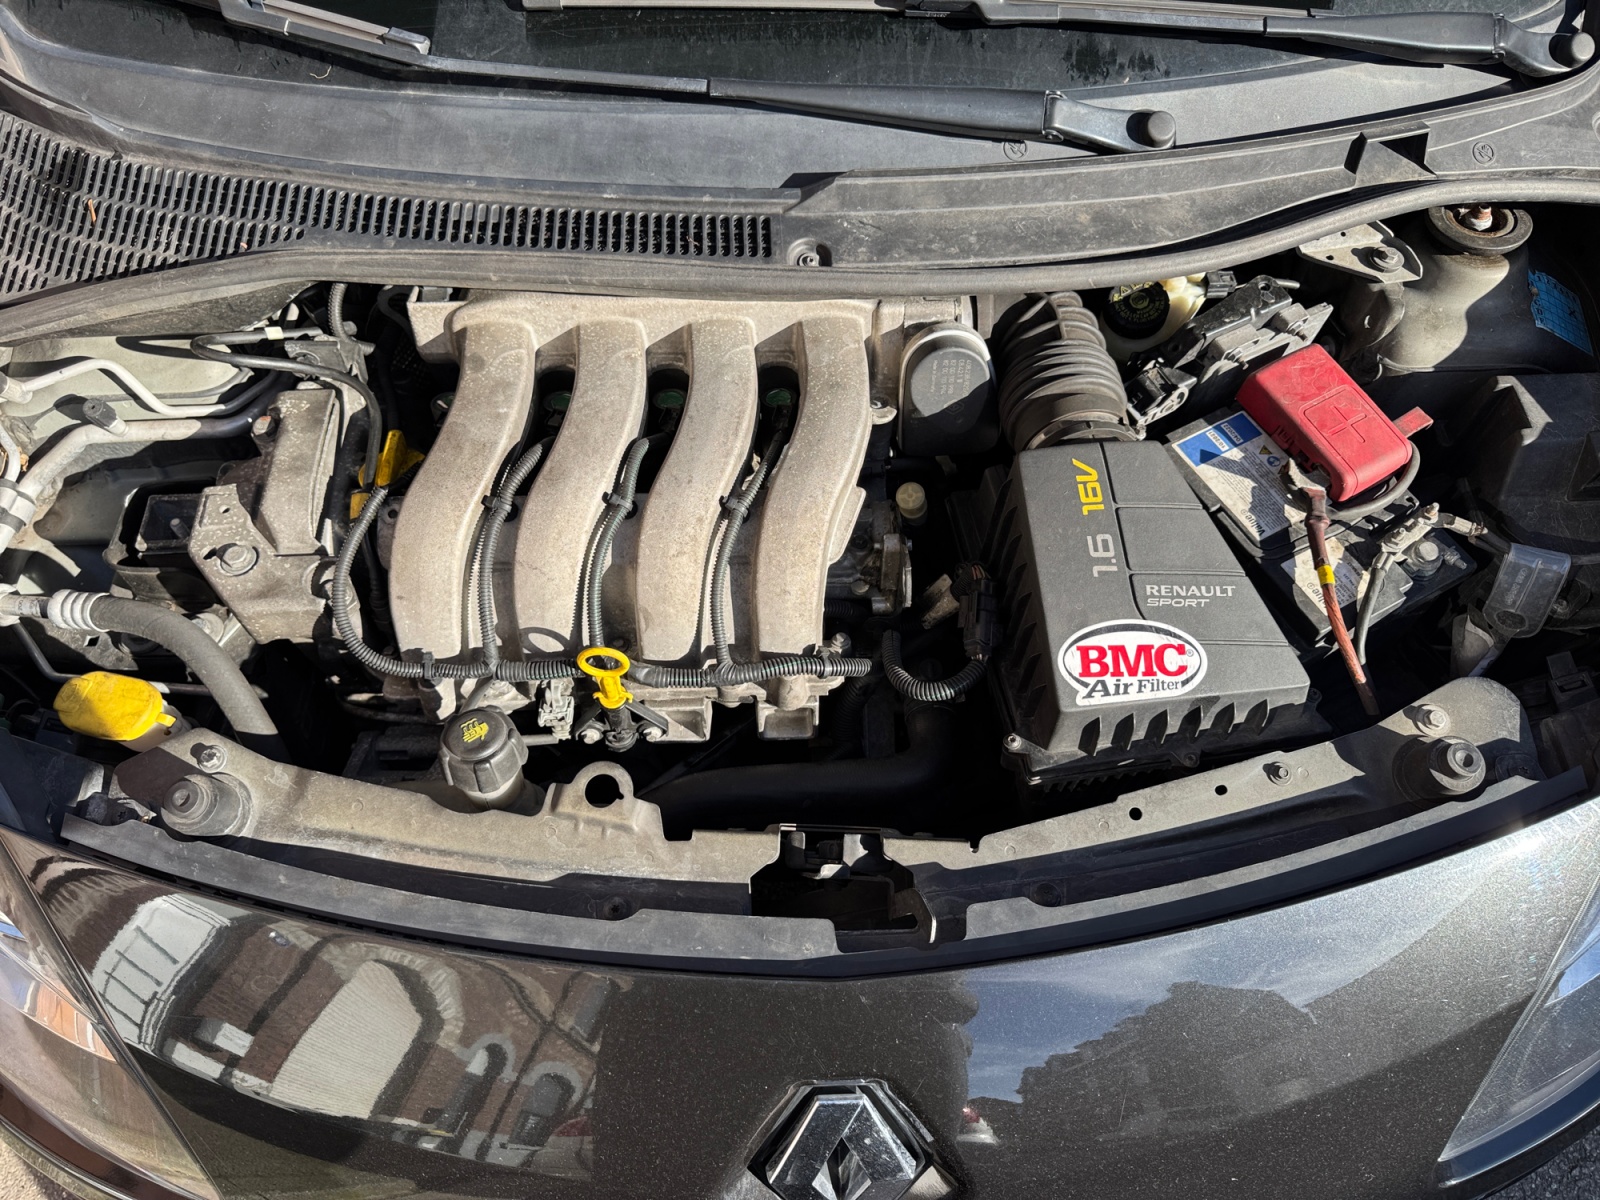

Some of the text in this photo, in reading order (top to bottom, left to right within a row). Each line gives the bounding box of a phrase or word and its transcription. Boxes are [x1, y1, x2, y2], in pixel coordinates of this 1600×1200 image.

[1072, 458, 1118, 577] 1.6 16V
[1245, 512, 1266, 536] Value
[1146, 585, 1236, 596] RENAULT
[1147, 598, 1210, 607] SPORT
[1076, 644, 1188, 678] BMC
[1082, 678, 1181, 699] Air Filter
